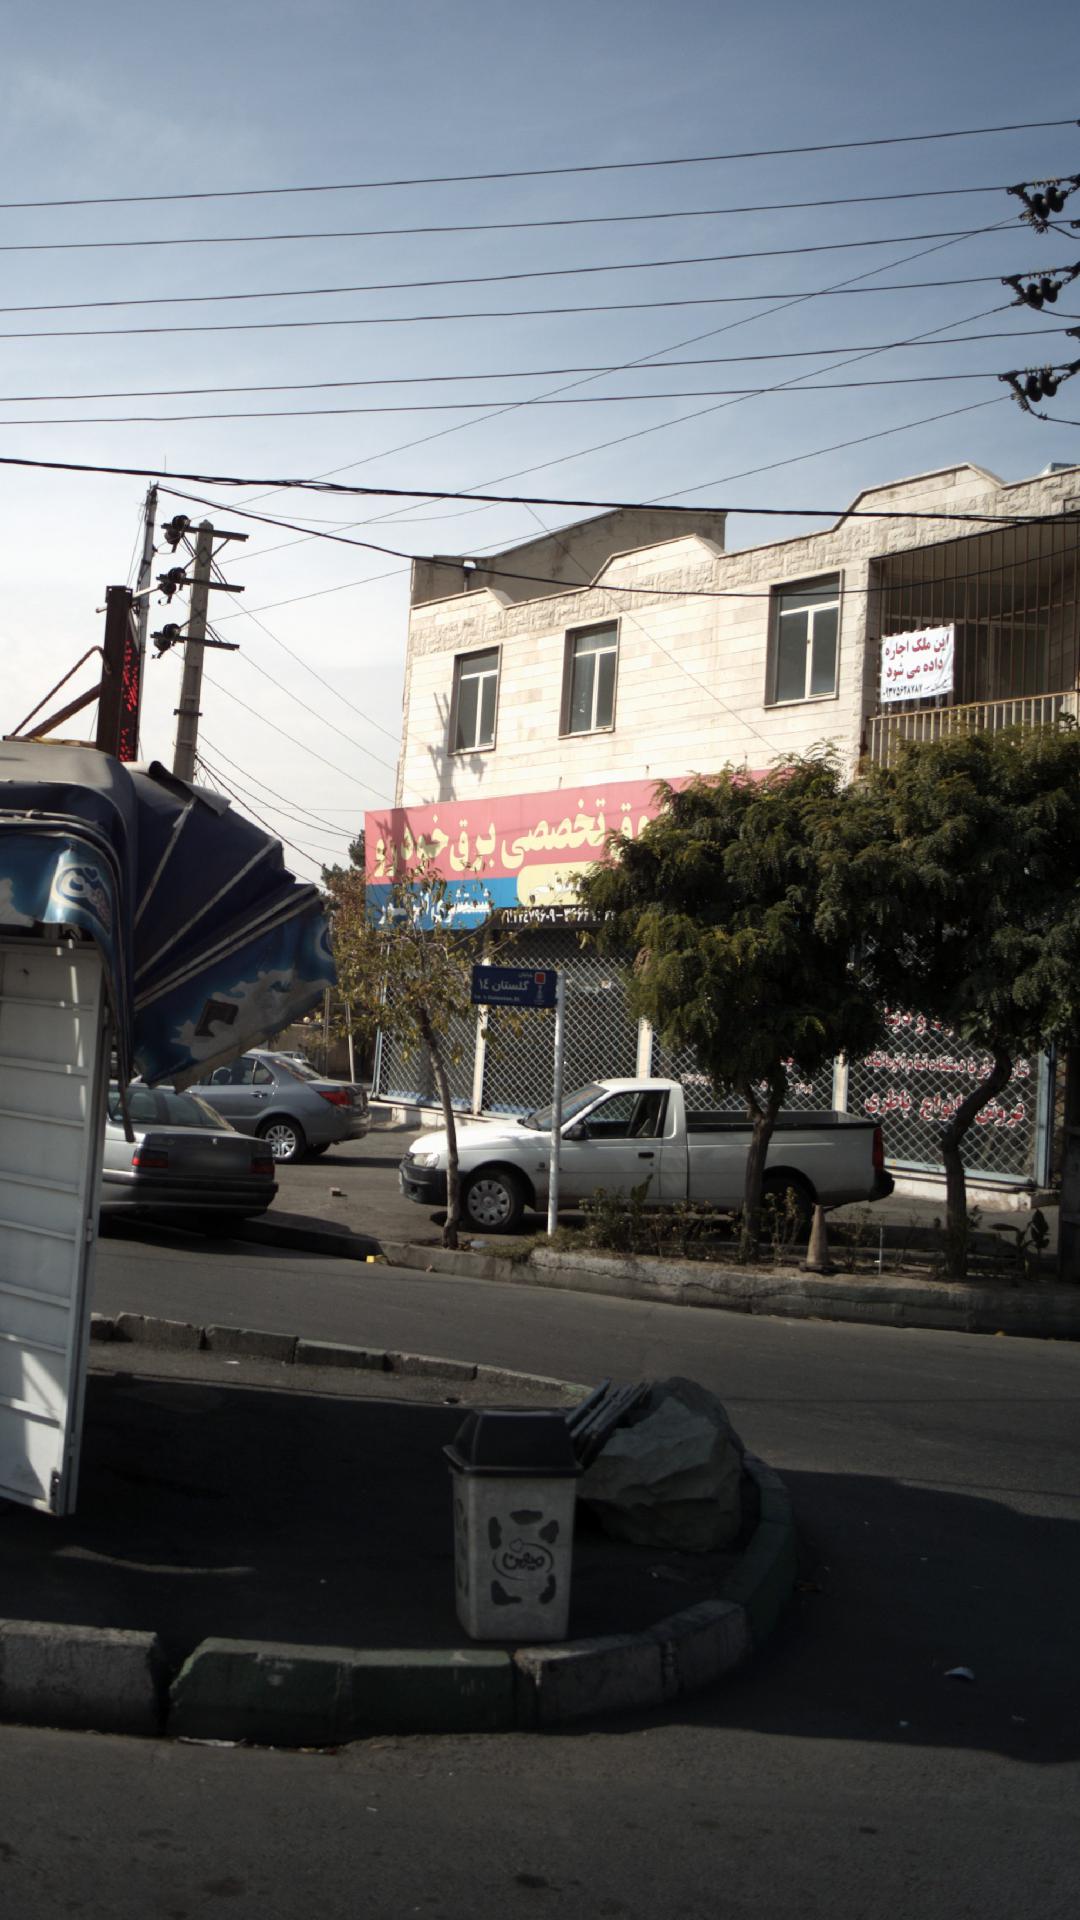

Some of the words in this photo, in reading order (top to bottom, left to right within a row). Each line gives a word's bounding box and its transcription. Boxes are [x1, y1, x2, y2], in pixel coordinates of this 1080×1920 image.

[885, 640, 909, 660] اجاره
[911, 637, 931, 653] ملک
[934, 633, 949, 653] این
[886, 662, 904, 681] شود
[906, 665, 920, 679] می
[923, 656, 944, 672] داده
[501, 798, 606, 869] تخصصی
[374, 814, 450, 878] خودرو
[449, 818, 497, 873] برق
[491, 979, 530, 993] گلستان
